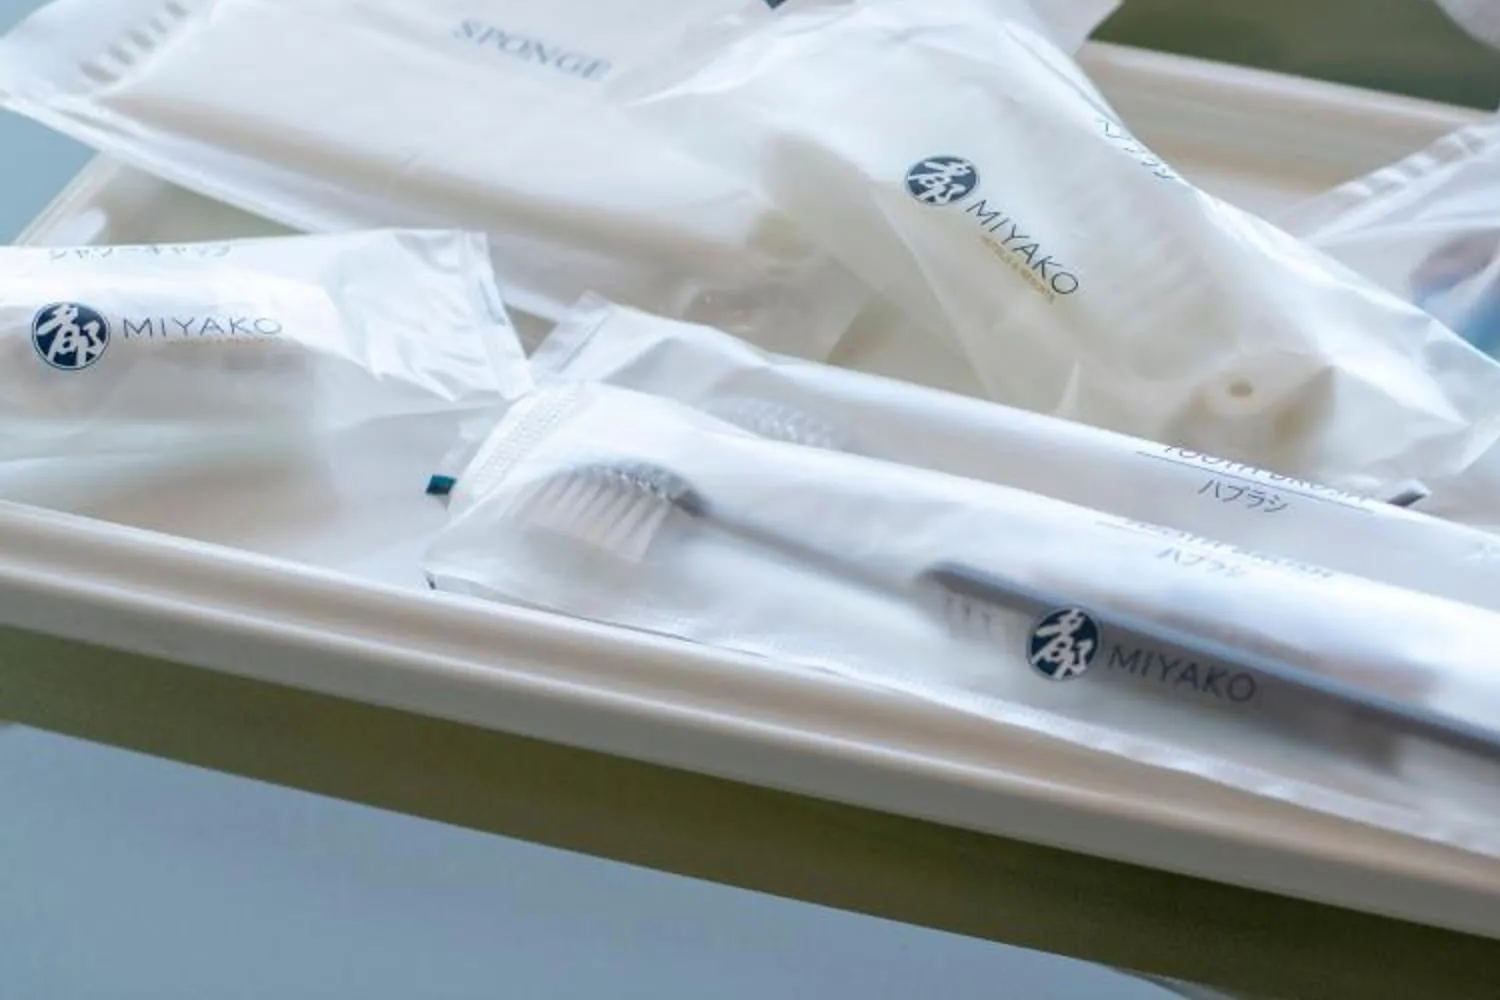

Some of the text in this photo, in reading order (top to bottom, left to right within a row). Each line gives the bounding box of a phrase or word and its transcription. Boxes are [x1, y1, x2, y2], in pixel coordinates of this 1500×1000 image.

[453, 20, 614, 81] SPONGE
[965, 199, 1079, 295] MIYAKO
[123, 317, 283, 340] MIYAKO
[1107, 643, 1257, 702] MIYAKO
